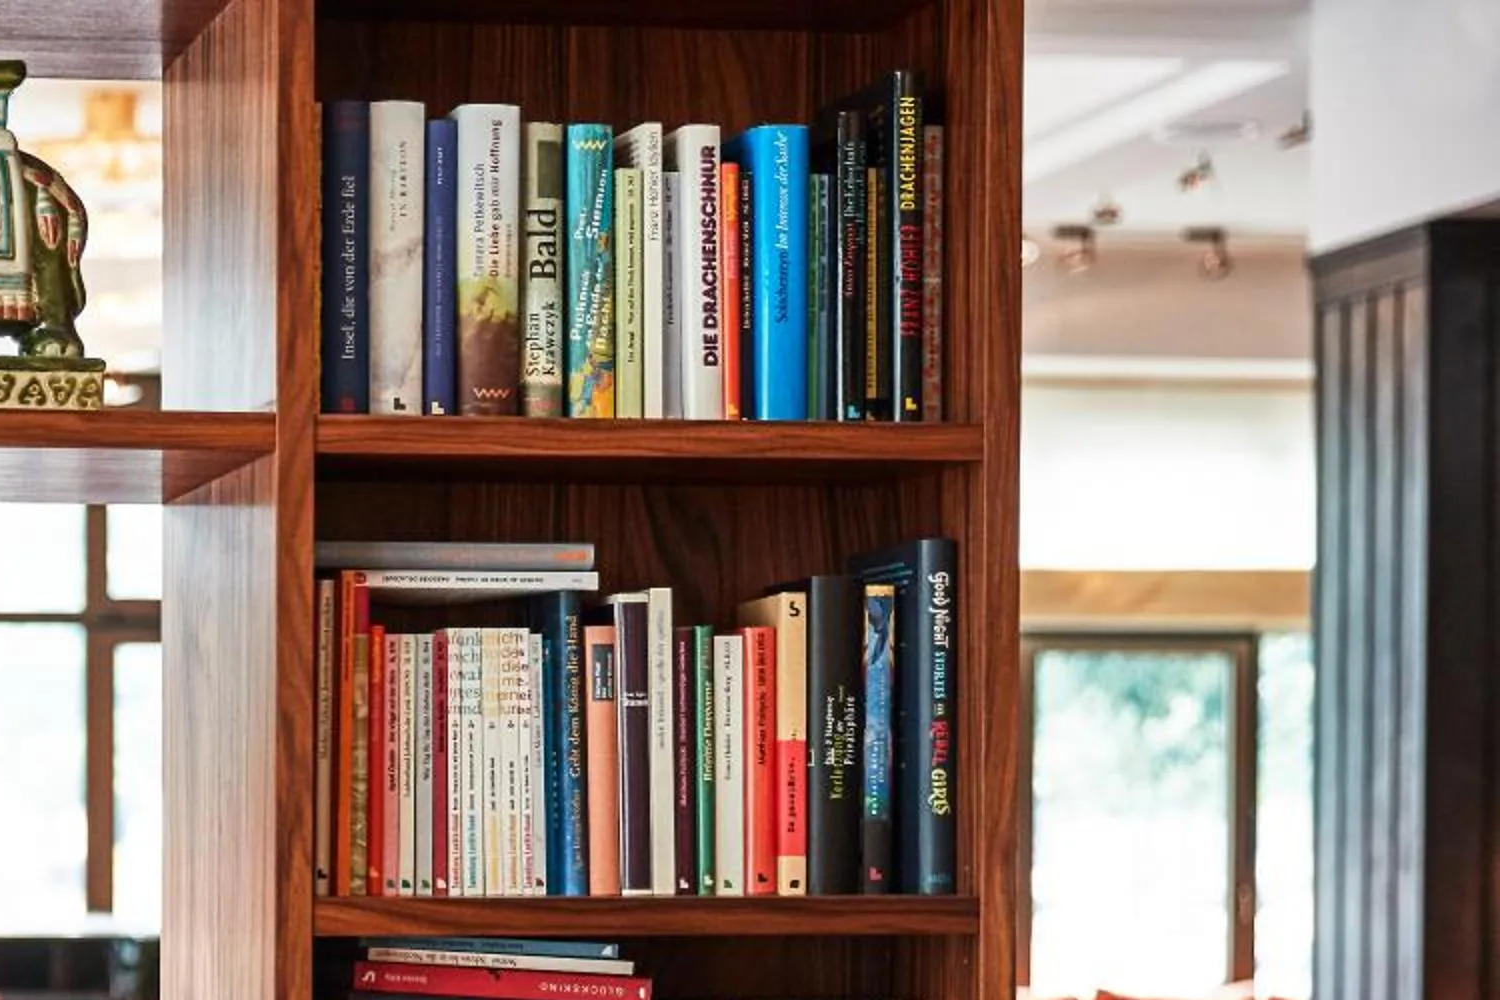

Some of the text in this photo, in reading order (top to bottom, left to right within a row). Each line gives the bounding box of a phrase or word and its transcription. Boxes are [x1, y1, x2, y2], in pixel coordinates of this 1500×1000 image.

[490, 120, 502, 173] Hoffnung
[900, 97, 916, 209] DRACHENJAGEN
[342, 202, 356, 233] Erde
[490, 200, 502, 220] gab
[342, 239, 356, 261] der
[490, 224, 502, 255] Liebe
[527, 208, 557, 282] Bald
[490, 259, 502, 278] Die
[701, 146, 718, 366] DIE DRACHENSCHNUR
[342, 265, 356, 290] von
[342, 296, 356, 317] die
[342, 321, 356, 359] Insel,
[526, 313, 542, 376] Stephan
[542, 301, 556, 376] Krawczyk
[567, 615, 581, 652] Hand
[567, 654, 581, 673] die
[567, 718, 581, 744] dem
